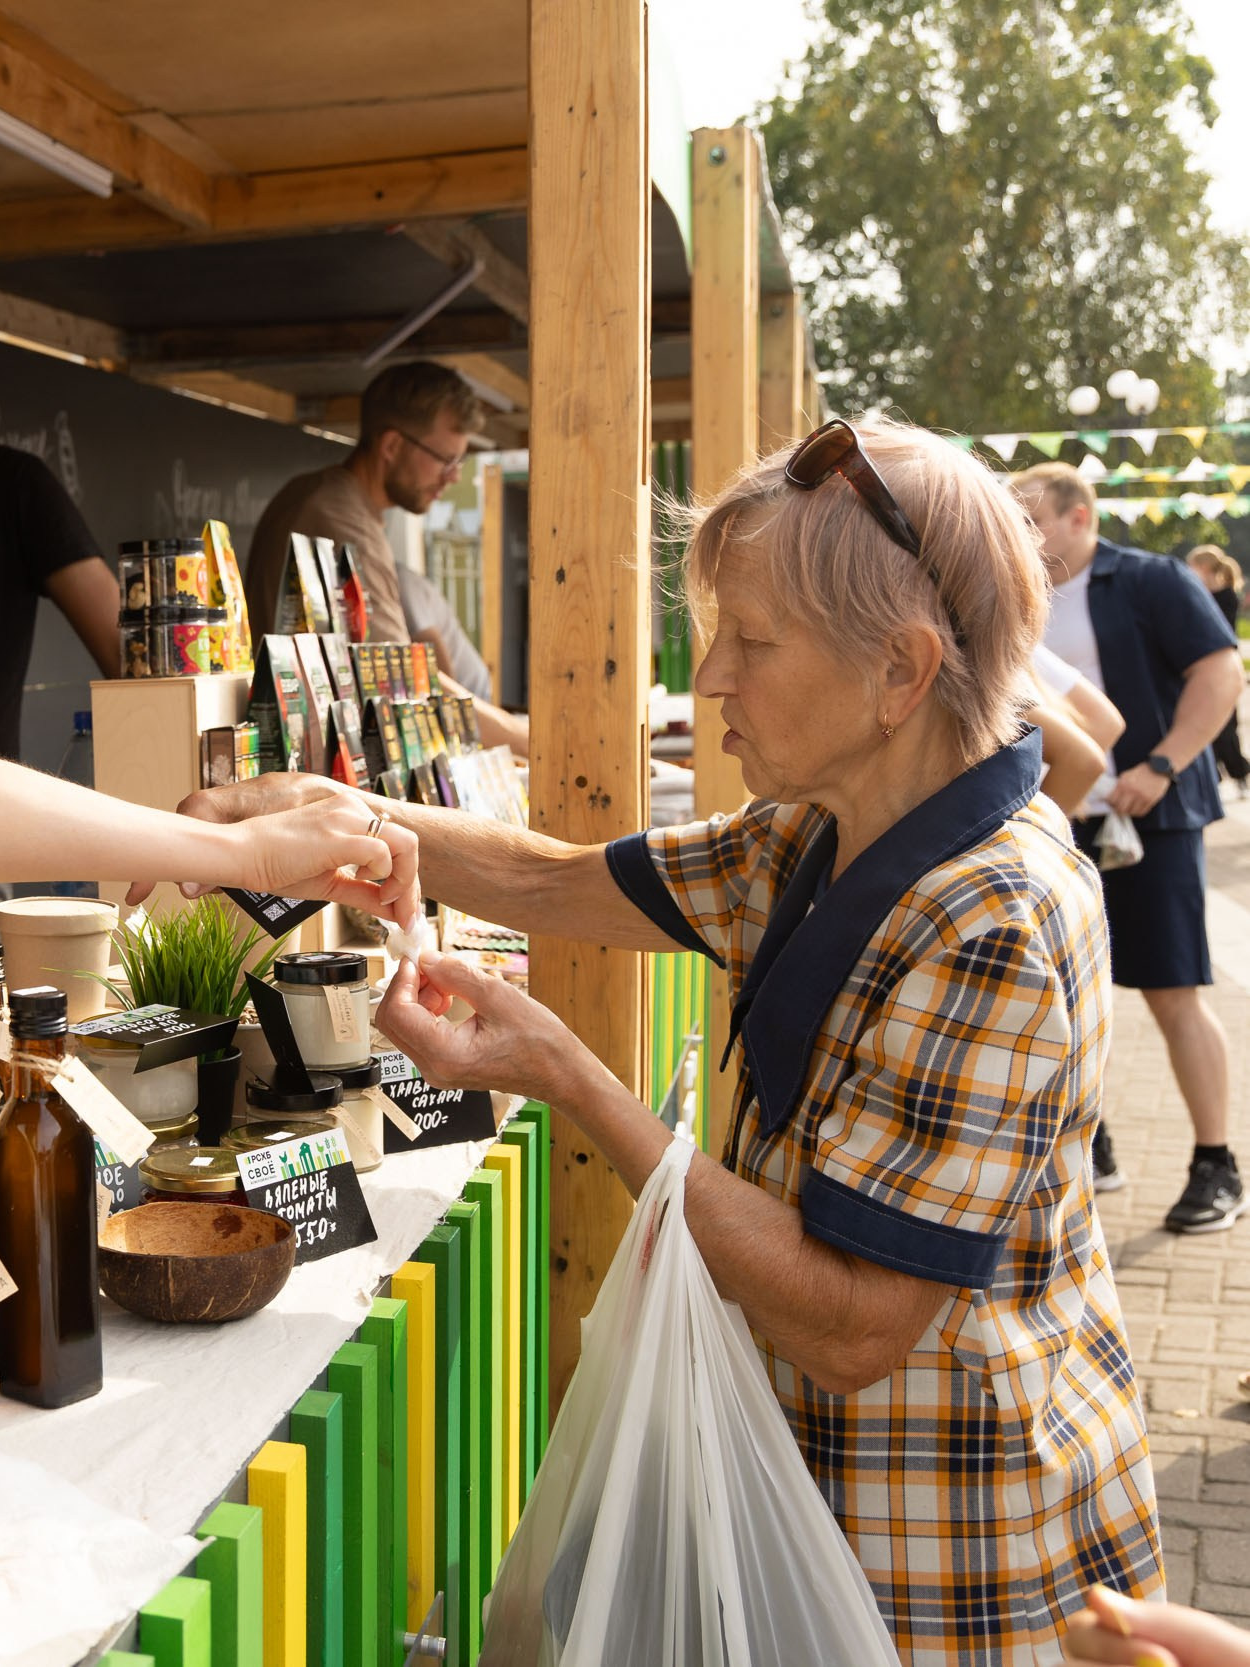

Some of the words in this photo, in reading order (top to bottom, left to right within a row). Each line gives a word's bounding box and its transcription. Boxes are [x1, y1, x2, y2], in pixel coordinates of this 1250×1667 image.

[382, 1053, 405, 1064] РСХБ
[412, 1088, 464, 1108] САХАРА
[251, 1150, 272, 1164] РСХБ
[247, 1160, 276, 1180] СВОЁ
[277, 1186, 337, 1220] ТОМАТЫ
